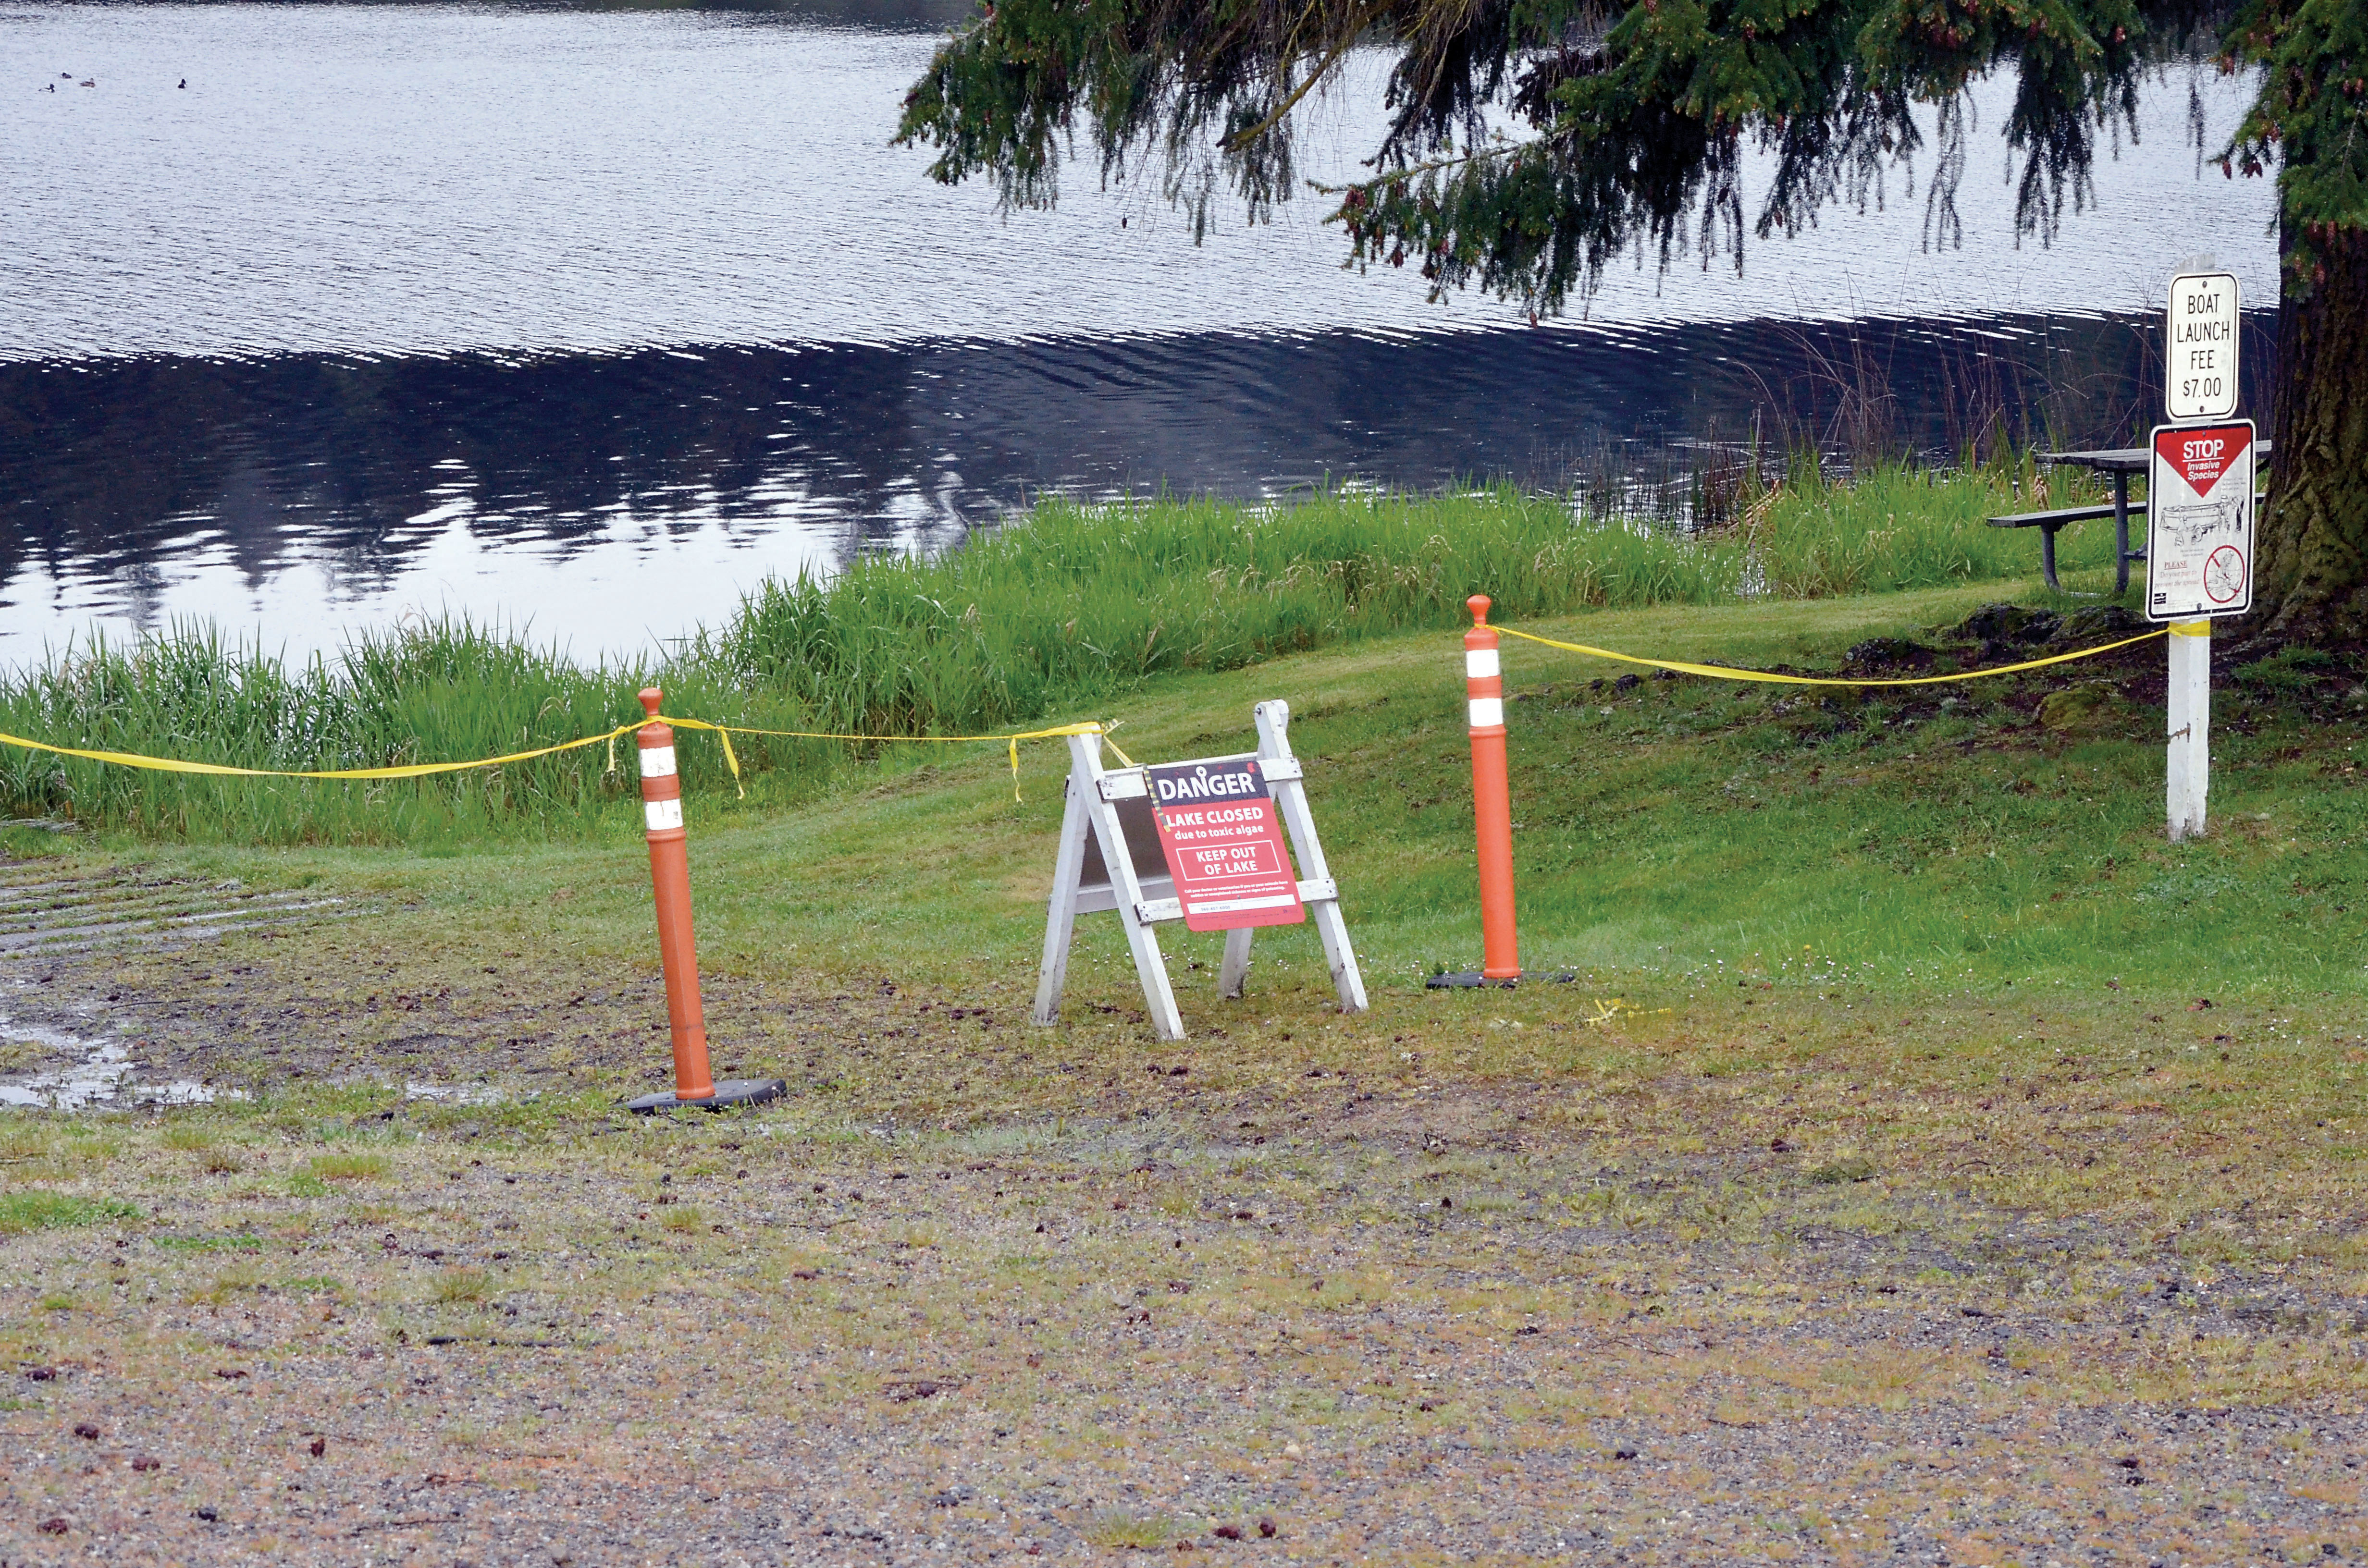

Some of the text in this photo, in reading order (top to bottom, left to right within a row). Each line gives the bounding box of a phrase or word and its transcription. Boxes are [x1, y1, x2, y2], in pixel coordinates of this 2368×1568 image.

[2188, 294, 2220, 314] BOAT
[2177, 321, 2229, 343] LAUNCH
[2191, 350, 2214, 369] FEE
[2183, 377, 2221, 398] $7.00
[2183, 439, 2224, 459] STOP
[2187, 461, 2220, 471] Invasive
[2188, 470, 2219, 482] Species
[2164, 561, 2187, 569] PLEASE
[1157, 772, 1256, 800] DANGER
[1166, 807, 1263, 827] LAKE CLOSED
[1174, 824, 1264, 840] due to toxic algae
[1196, 846, 1256, 862] KEEP OUT
[1204, 860, 1258, 875] OF LAKE
